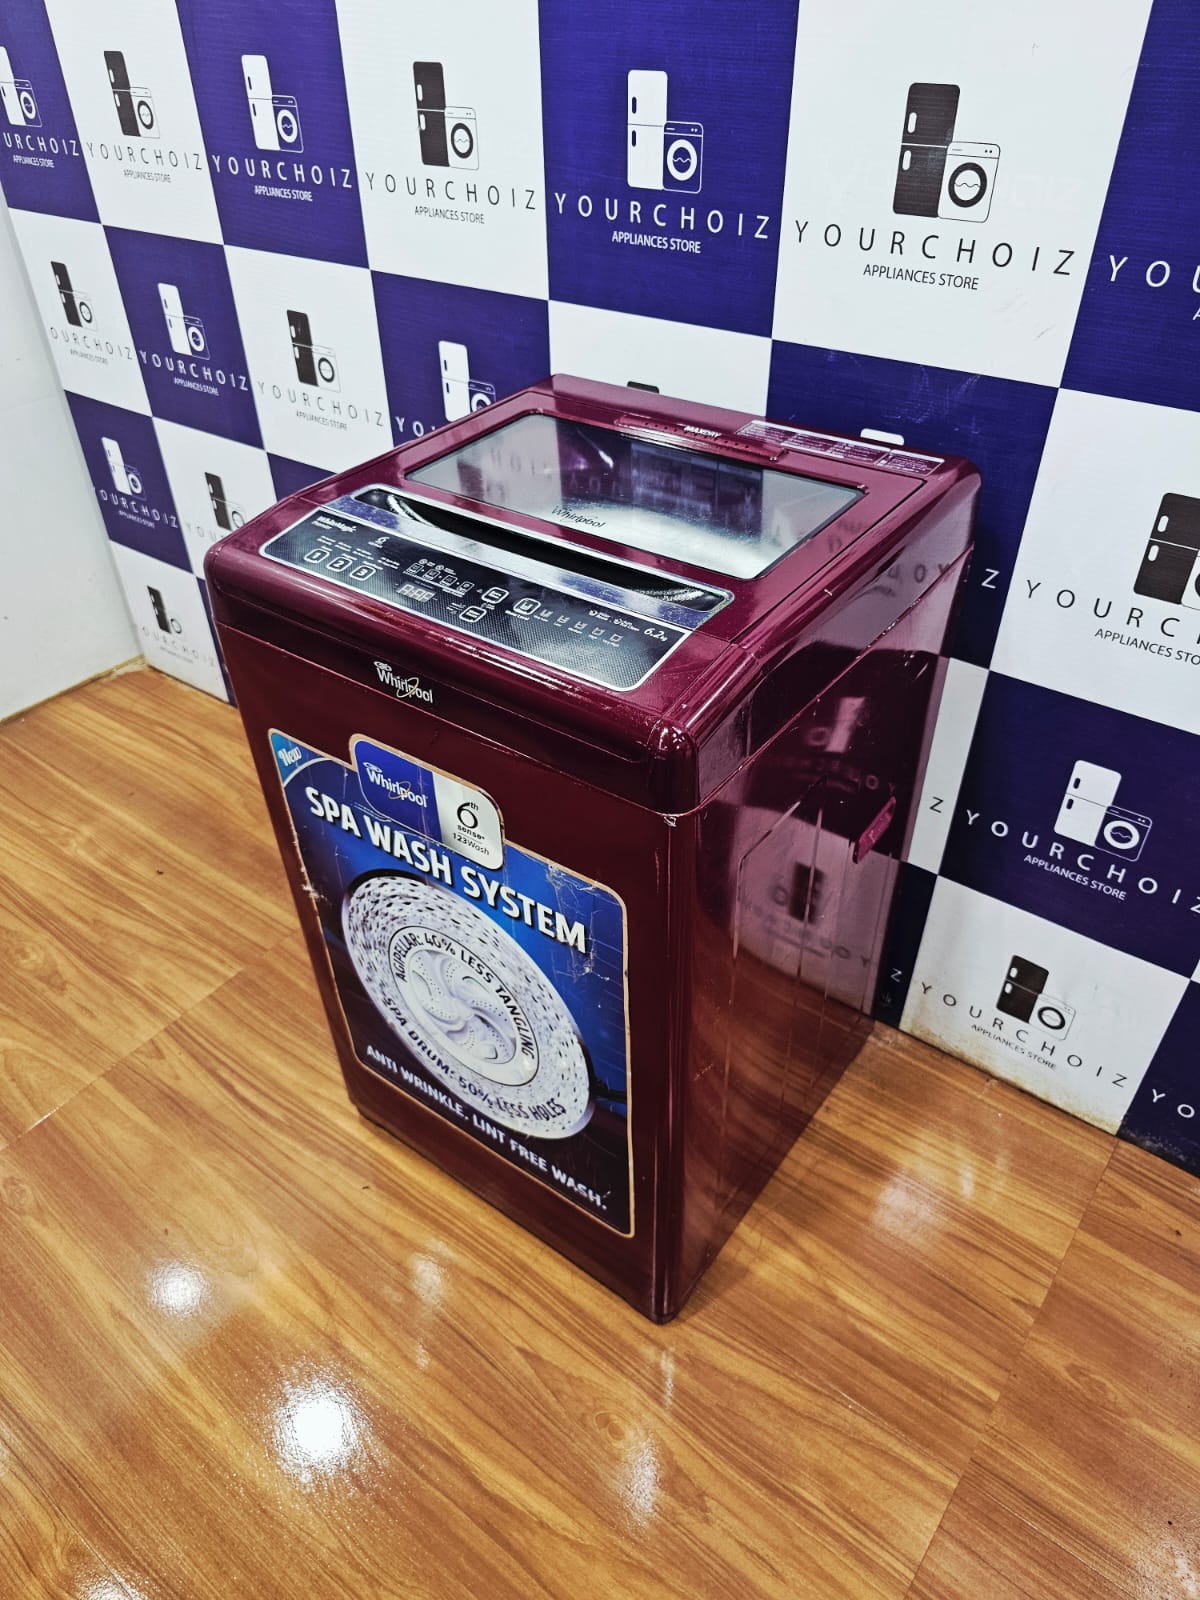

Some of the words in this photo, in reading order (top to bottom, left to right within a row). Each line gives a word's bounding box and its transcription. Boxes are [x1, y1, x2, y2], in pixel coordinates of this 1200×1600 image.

[86, 141, 203, 171] YOURCHOIZ
[212, 154, 352, 189] YOURCHOIZ
[254, 184, 292, 199] APPLIANCES
[292, 189, 313, 202] STORE
[365, 171, 537, 210] YOURCHOIZ
[414, 205, 459, 221] APPLIANCES
[460, 211, 486, 225] STORE
[554, 191, 770, 240] YOURCHOIZ
[611, 229, 669, 251] APPLIANCES
[669, 236, 702, 255] STORE
[795, 219, 1076, 276] YOURCHOIZ
[862, 262, 937, 286] APPLIANCES
[938, 272, 980, 291] STORE
[139, 349, 249, 391] YOURCHOIZ
[257, 380, 383, 427] YOURCHOIZ
[1094, 627, 1173, 658] APPLIANCES
[375, 666, 434, 704] Whirlpool
[277, 746, 303, 767] New
[365, 766, 428, 808] Whirlpool
[452, 832, 490, 856] 123Wash
[304, 785, 362, 838] SPA
[363, 814, 453, 887] WASH
[459, 866, 588, 955] SYSTEM
[1023, 853, 1089, 887] APPLIANCES
[1089, 878, 1127, 901] STORE
[424, 931, 457, 956] 40%
[460, 949, 494, 984] LESS
[495, 985, 536, 1060] TANGLING
[920, 981, 1128, 1088] YOURCHOIZ
[971, 1023, 1026, 1055] APPLIANCES
[1026, 1050, 1058, 1072] STORE
[381, 996, 407, 1027] SPA
[458, 1074, 494, 1110] 50%
[528, 1097, 567, 1122] HOLES
[366, 1044, 399, 1074] ANTI
[472, 1113, 507, 1145] LINT
[510, 1138, 549, 1173] FREE
